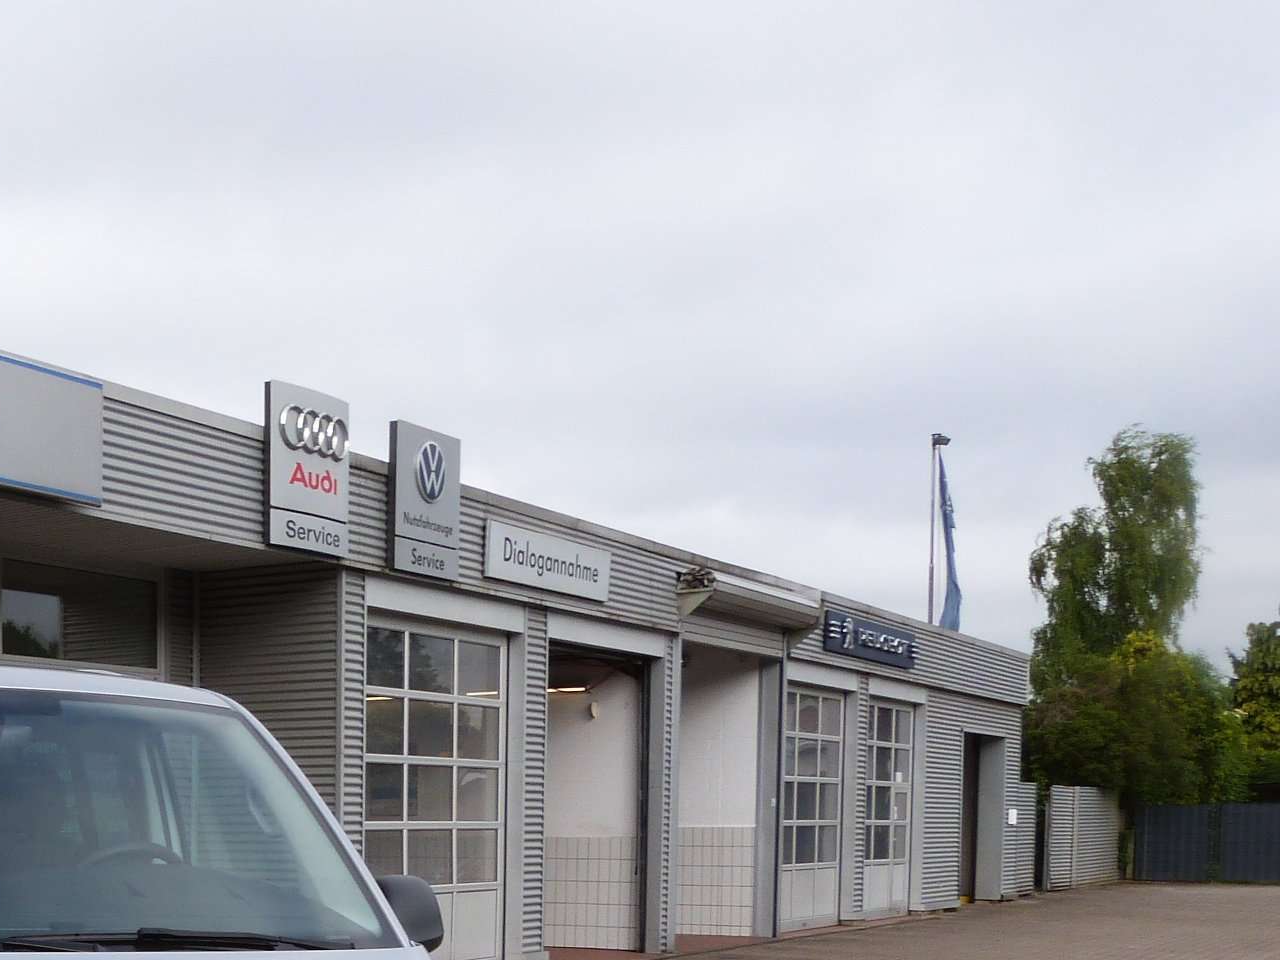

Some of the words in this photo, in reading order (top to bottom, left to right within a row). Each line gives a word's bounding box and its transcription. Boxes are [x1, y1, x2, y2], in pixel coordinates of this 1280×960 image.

[289, 462, 338, 495] Audi
[285, 519, 341, 549] Service
[411, 547, 445, 572] Service
[503, 537, 599, 584] Dialogannahme
